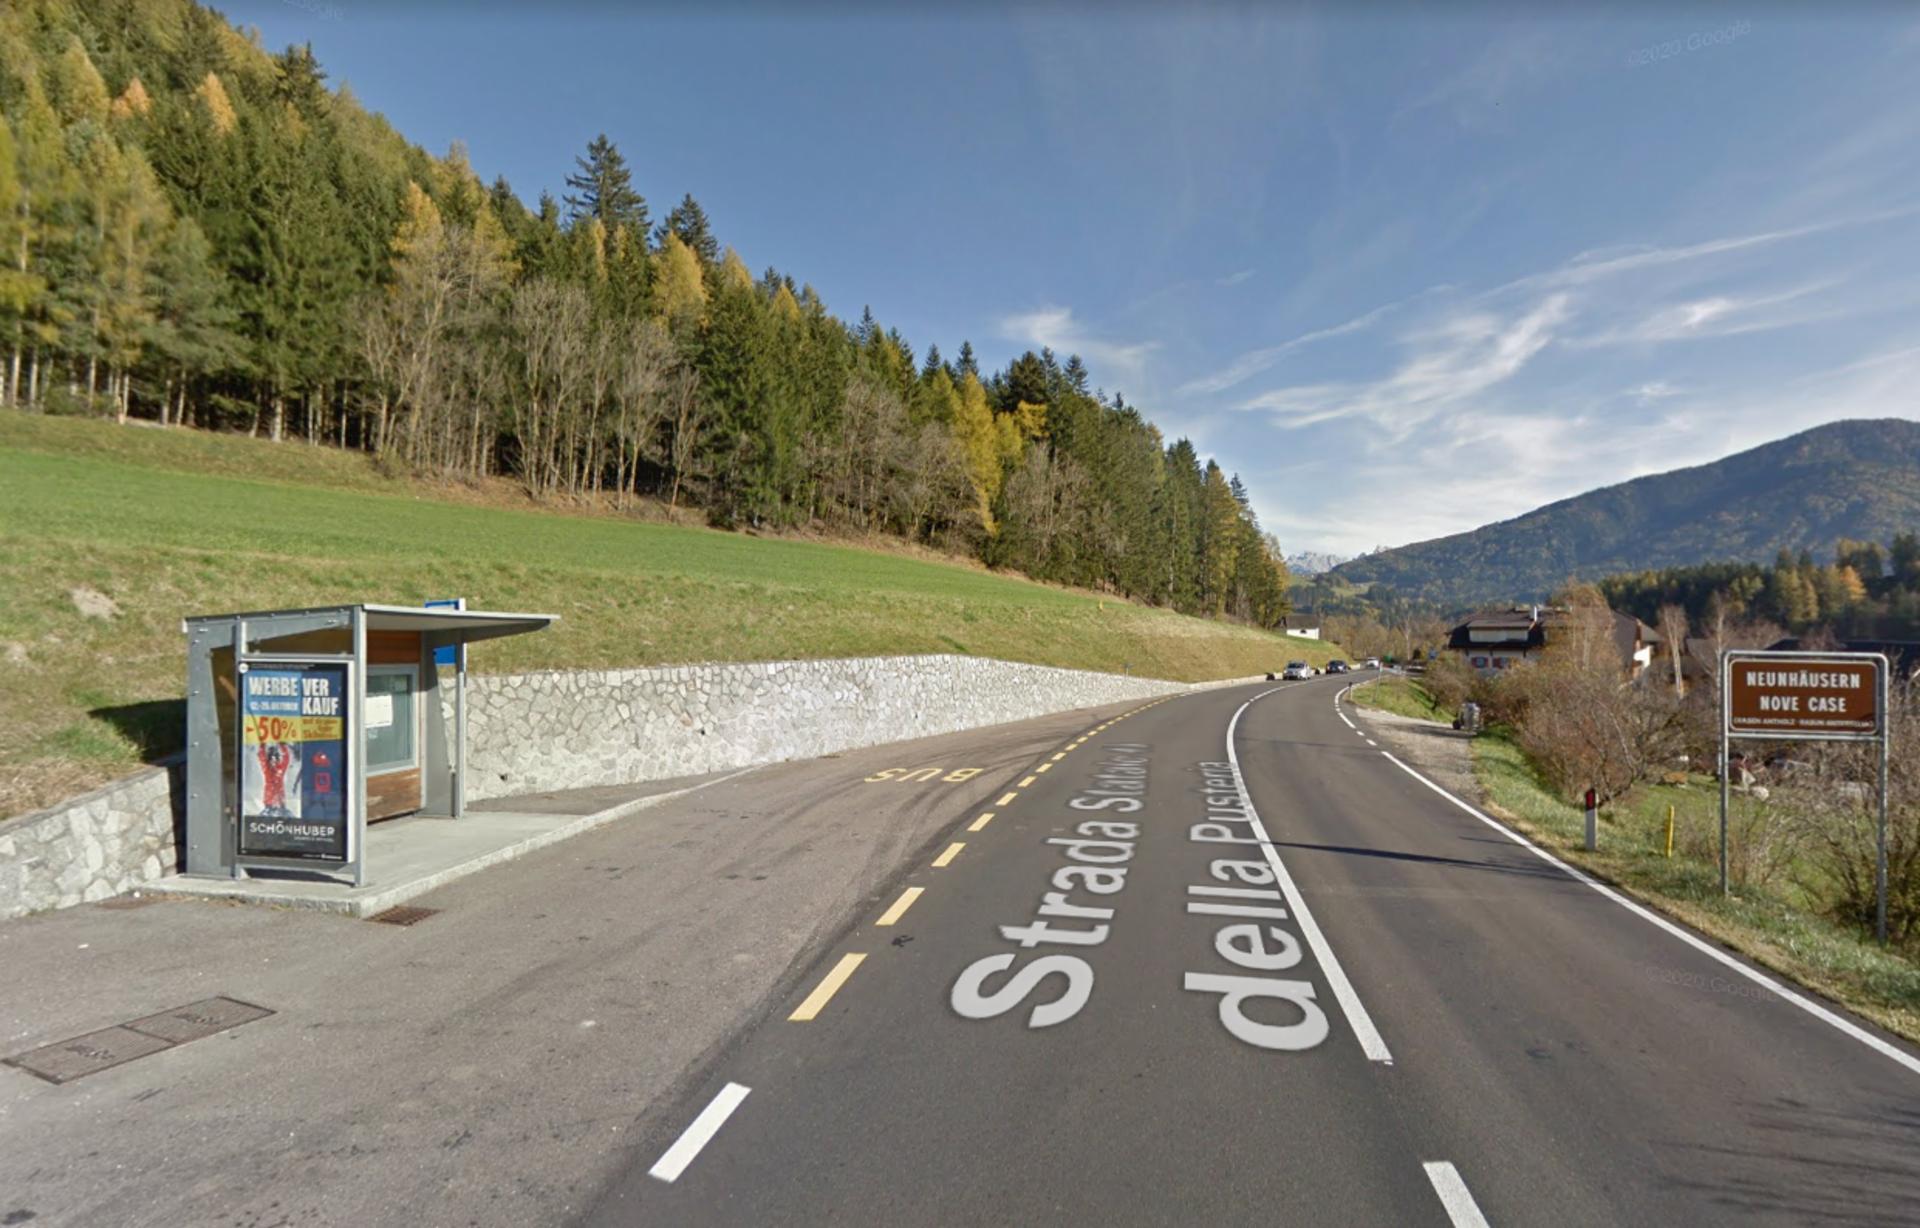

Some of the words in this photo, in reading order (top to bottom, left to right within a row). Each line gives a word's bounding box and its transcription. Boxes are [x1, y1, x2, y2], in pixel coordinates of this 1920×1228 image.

[248, 676, 298, 697] WERBE
[301, 677, 330, 697] VER
[1746, 671, 1861, 688] NEUNHÄUSERN
[301, 696, 340, 716] KAUF
[1759, 695, 1800, 712] NOVE
[1807, 697, 1847, 713] CASE
[863, 767, 984, 783] BUS
[249, 820, 336, 837] SCHÖNHUBER
